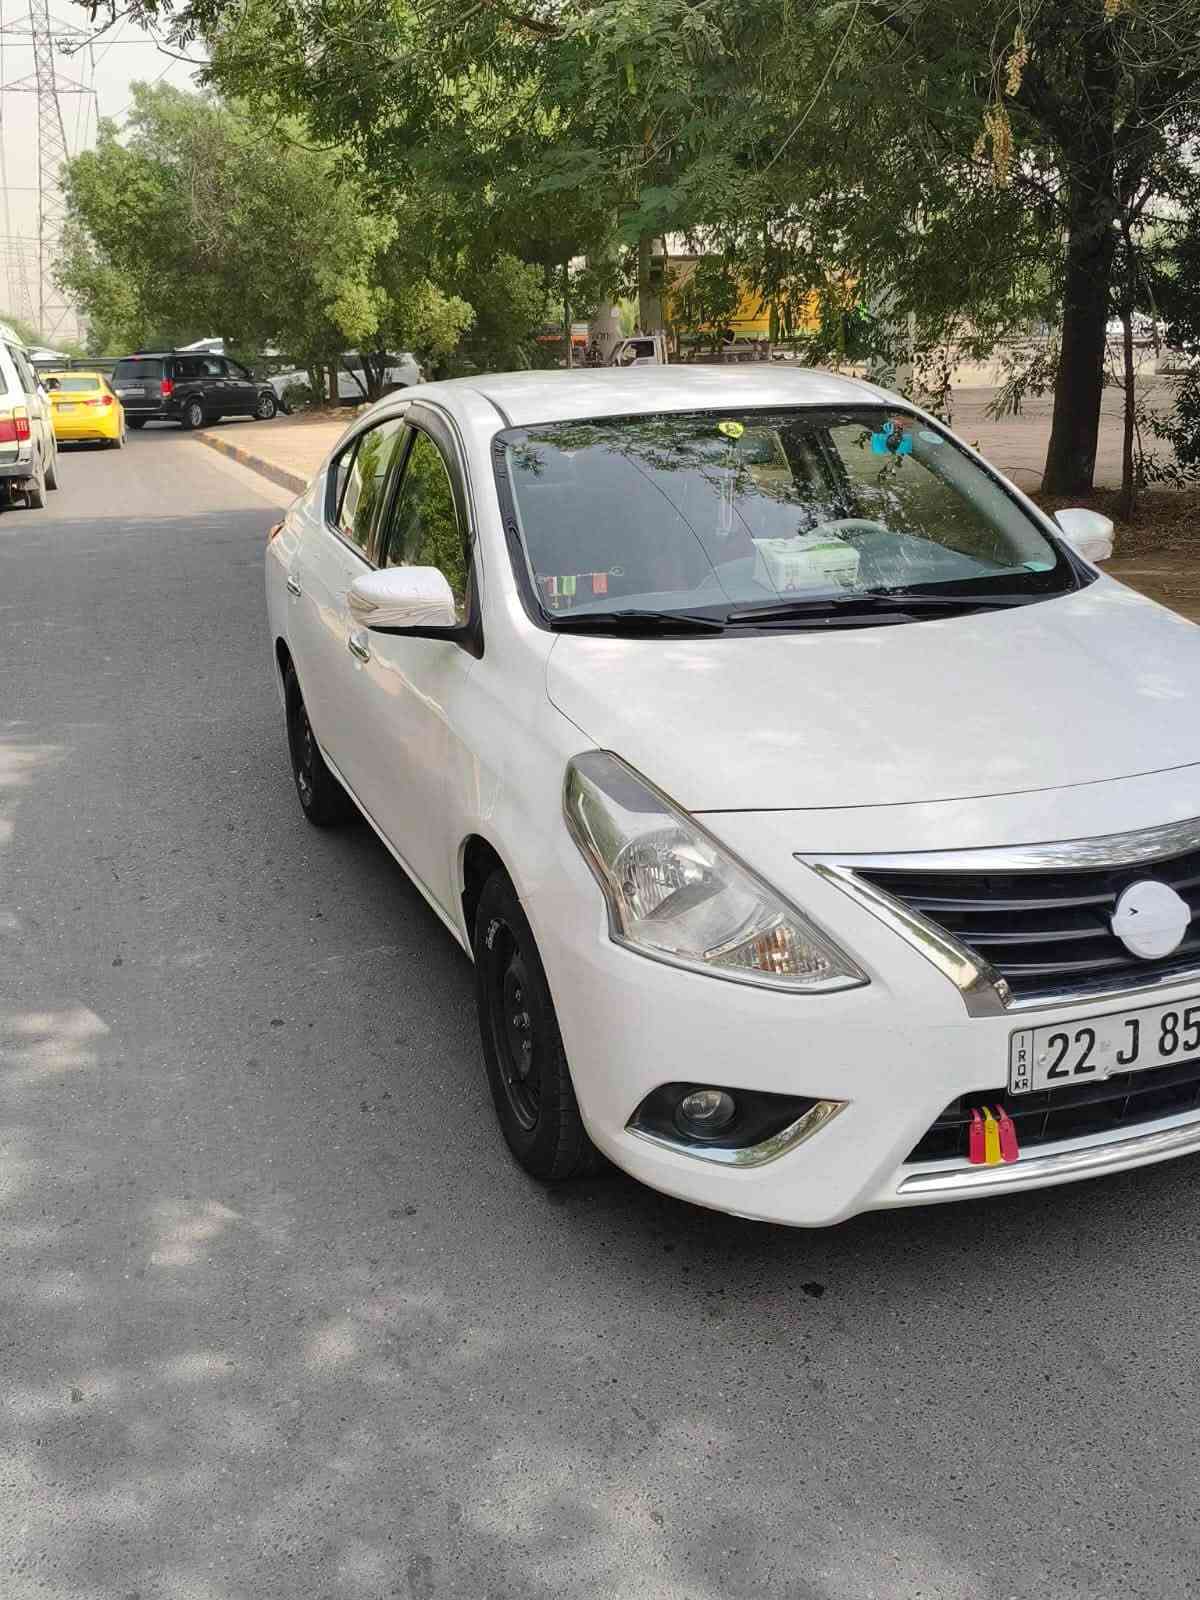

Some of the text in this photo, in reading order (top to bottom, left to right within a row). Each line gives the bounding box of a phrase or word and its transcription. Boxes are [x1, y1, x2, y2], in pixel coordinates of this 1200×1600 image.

[1047, 1006, 1200, 1080] 22 J 85
